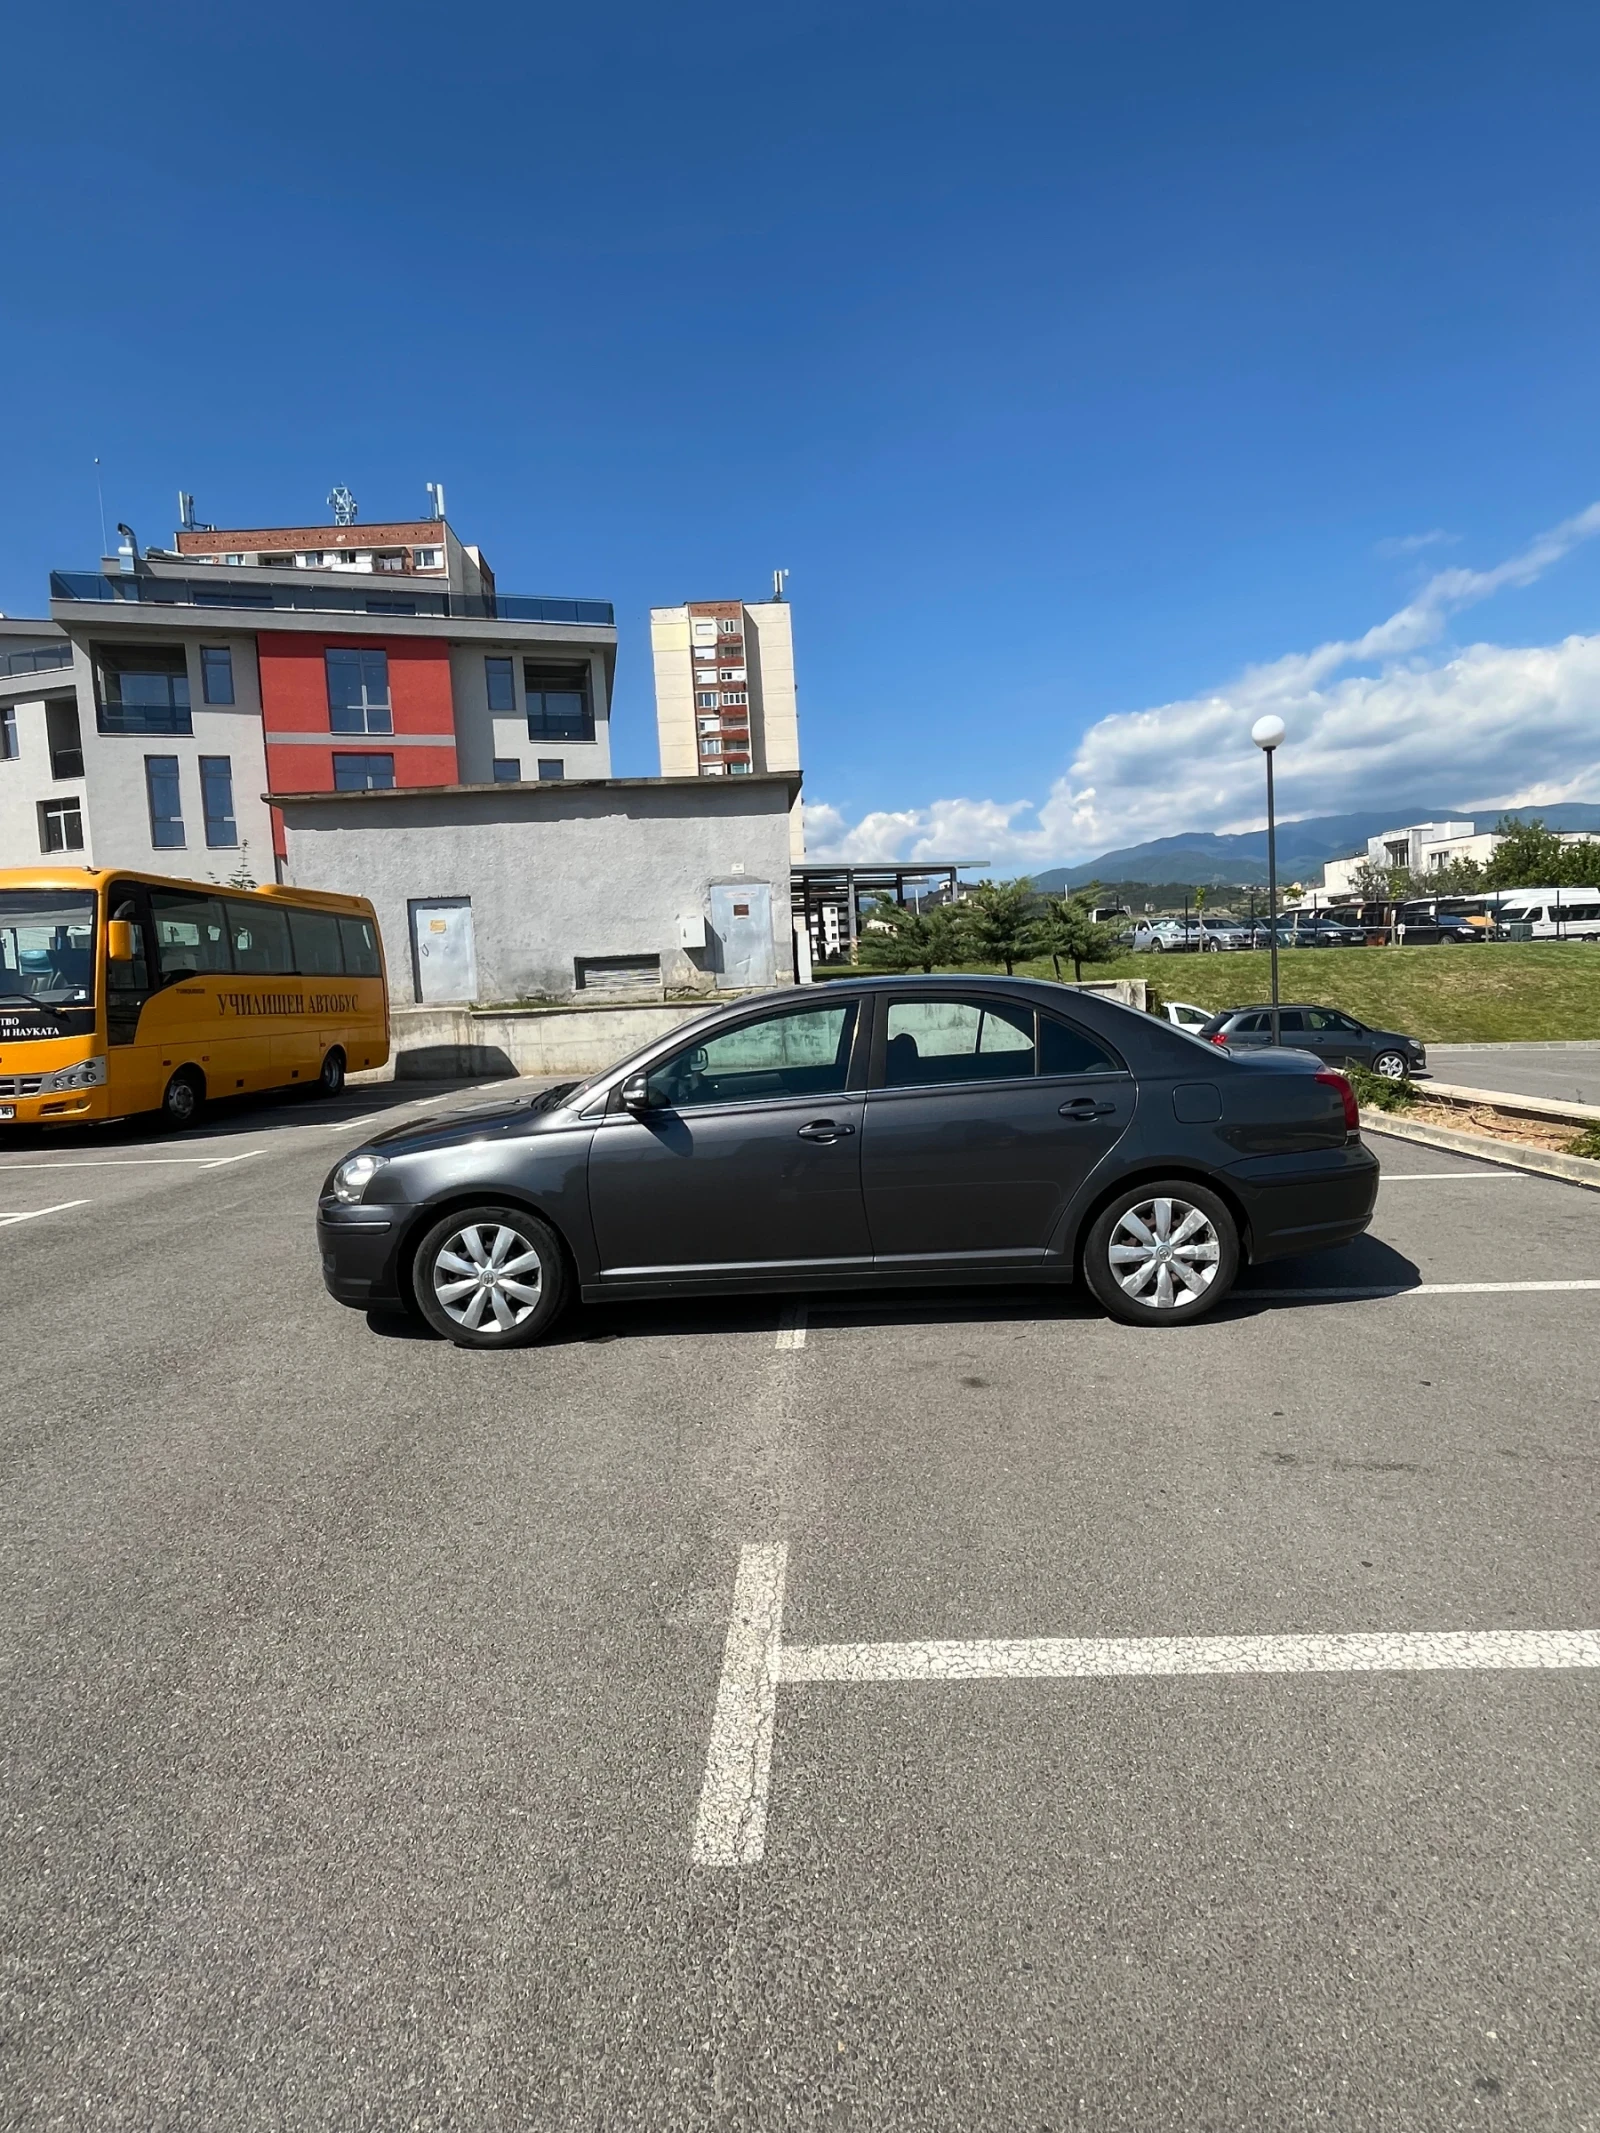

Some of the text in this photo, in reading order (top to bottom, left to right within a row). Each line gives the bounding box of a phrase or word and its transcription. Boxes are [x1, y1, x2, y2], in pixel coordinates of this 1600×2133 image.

[216, 993, 359, 1016] УЧИЛИЩЕН АВТОБУС
[12, 1027, 59, 1036] НАУКАТА
